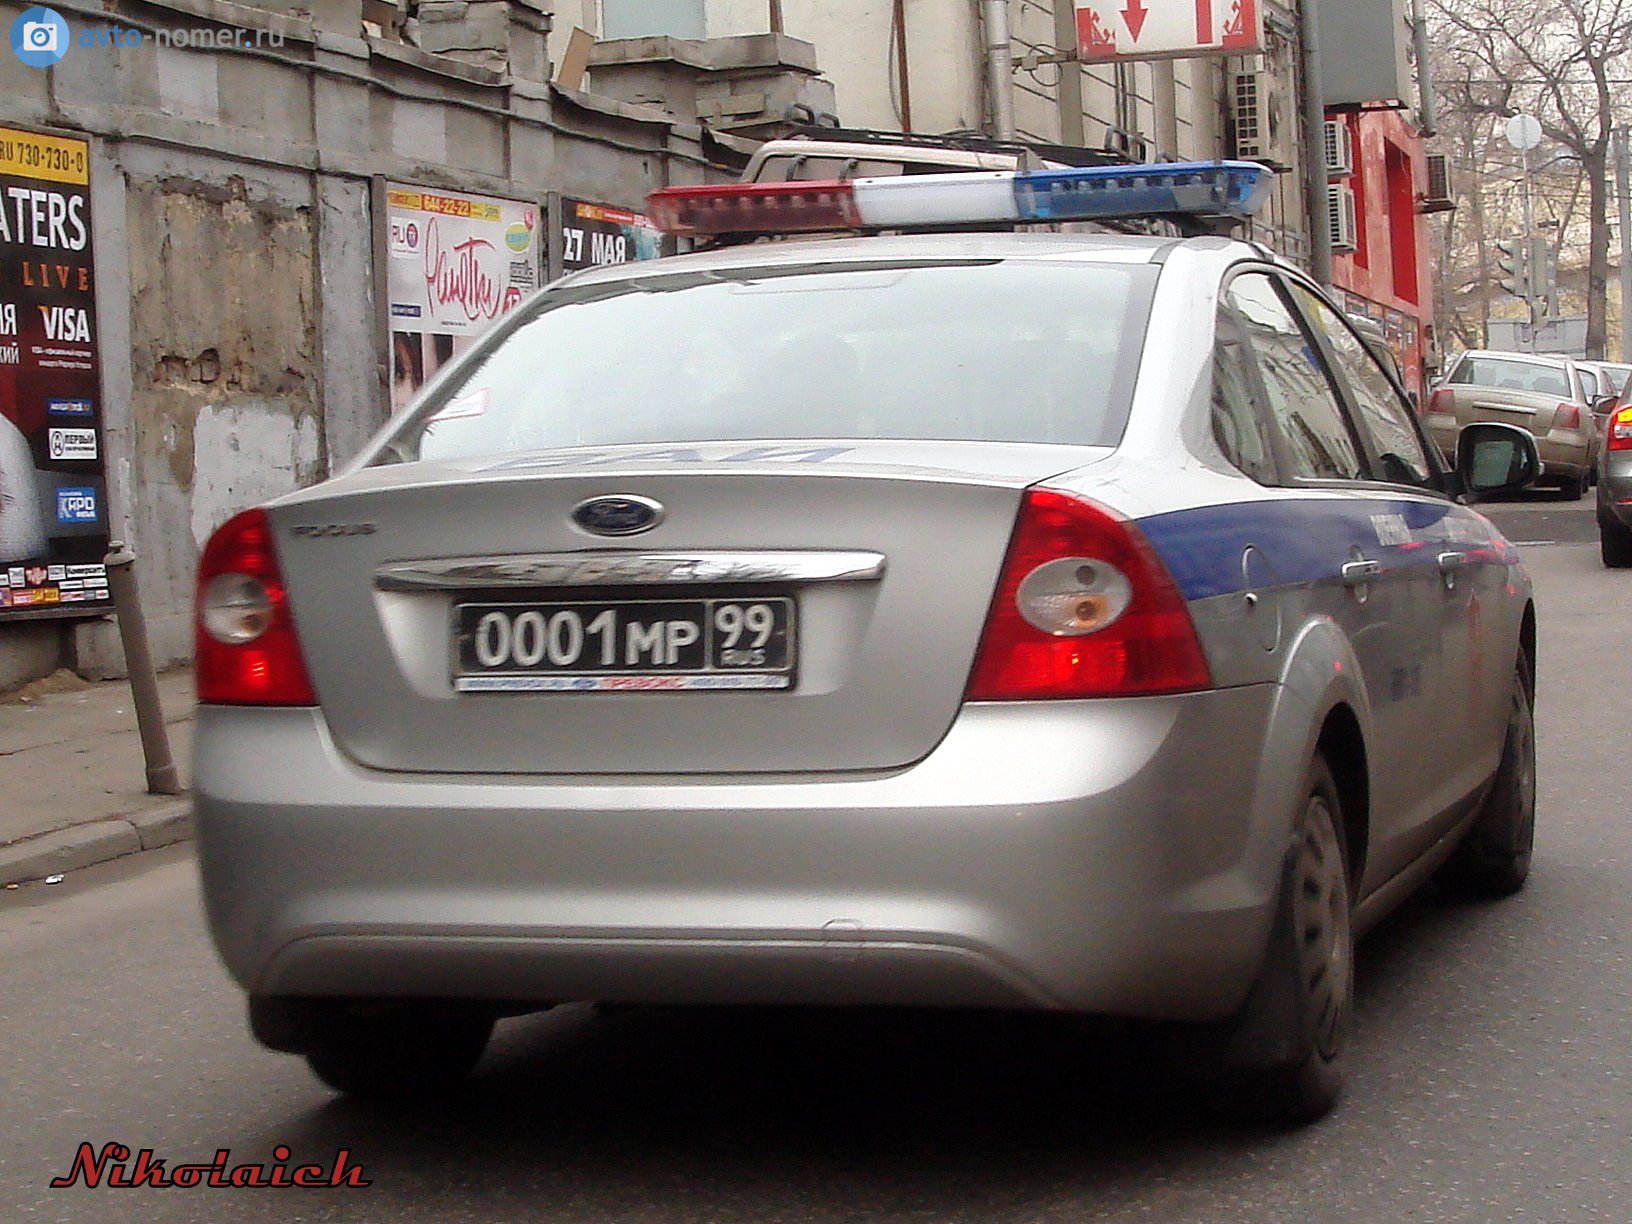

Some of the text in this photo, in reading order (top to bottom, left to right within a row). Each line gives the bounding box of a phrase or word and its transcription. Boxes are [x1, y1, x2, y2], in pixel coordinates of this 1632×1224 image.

[563, 227, 627, 265] 27 МАЯ
[22, 261, 89, 291] LIVE
[37, 305, 90, 343] VISA
[714, 604, 775, 649] 99
